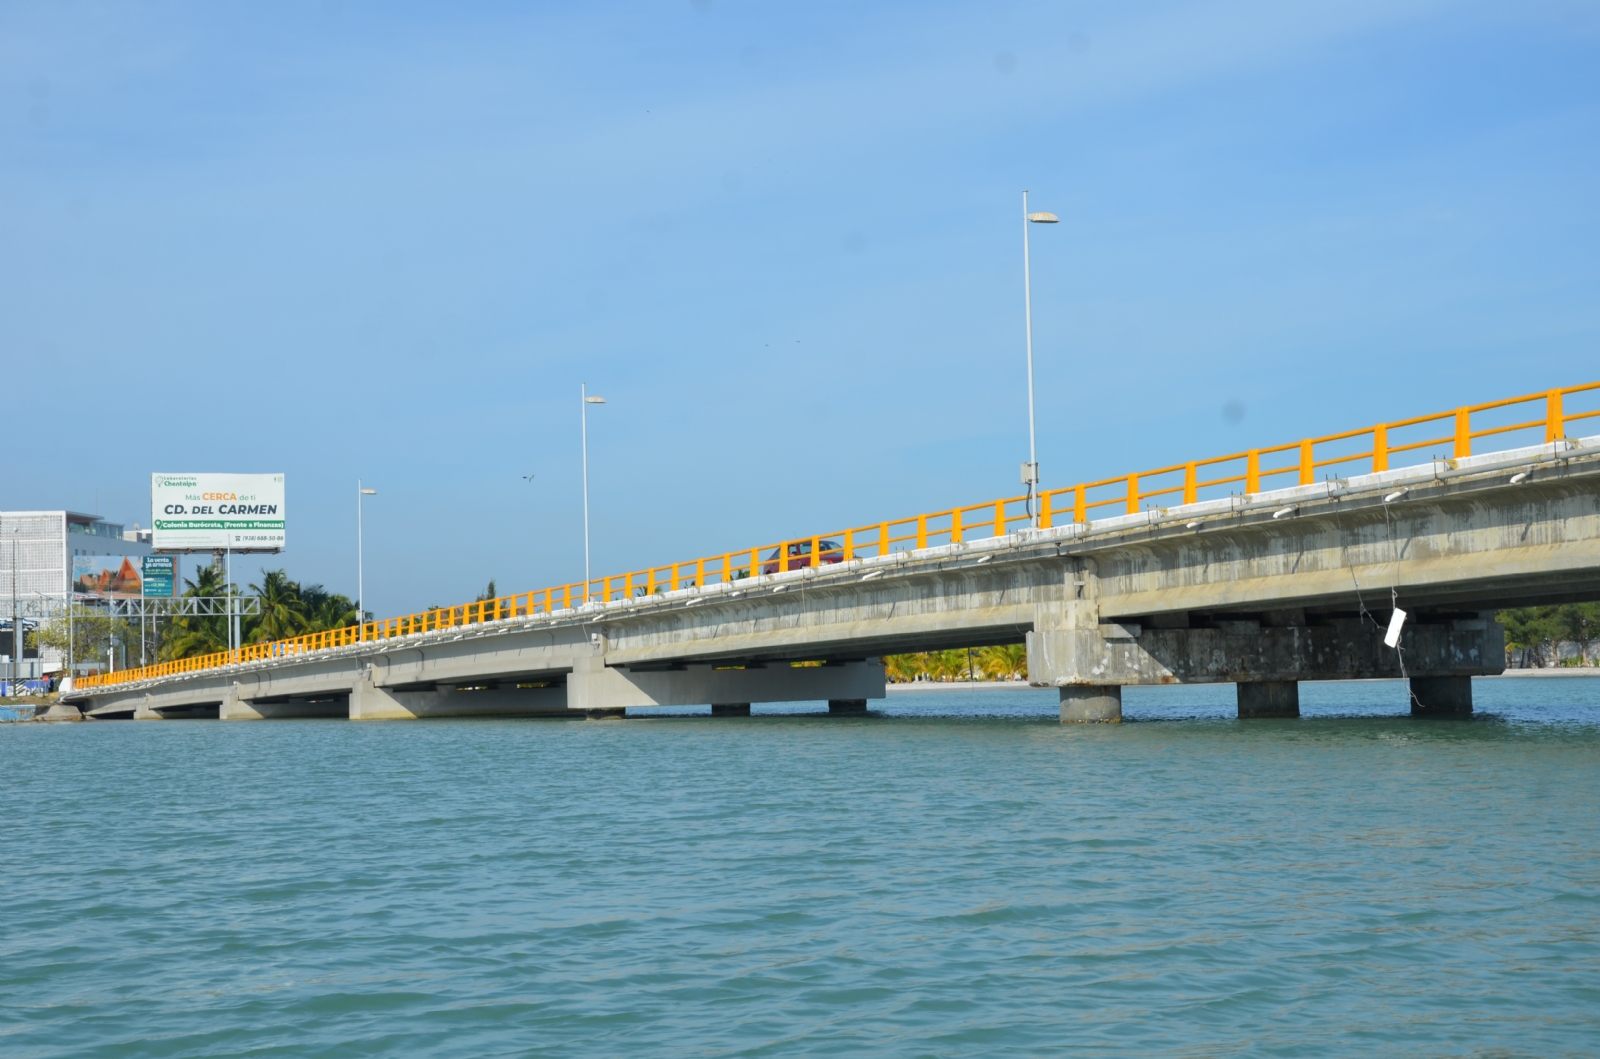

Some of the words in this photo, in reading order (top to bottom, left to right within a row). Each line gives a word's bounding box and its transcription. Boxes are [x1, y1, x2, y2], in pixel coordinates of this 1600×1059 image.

[202, 492, 237, 501] CERCA
[164, 504, 187, 515] CD.
[192, 506, 214, 514] DEL
[219, 504, 277, 515] CARMEN
